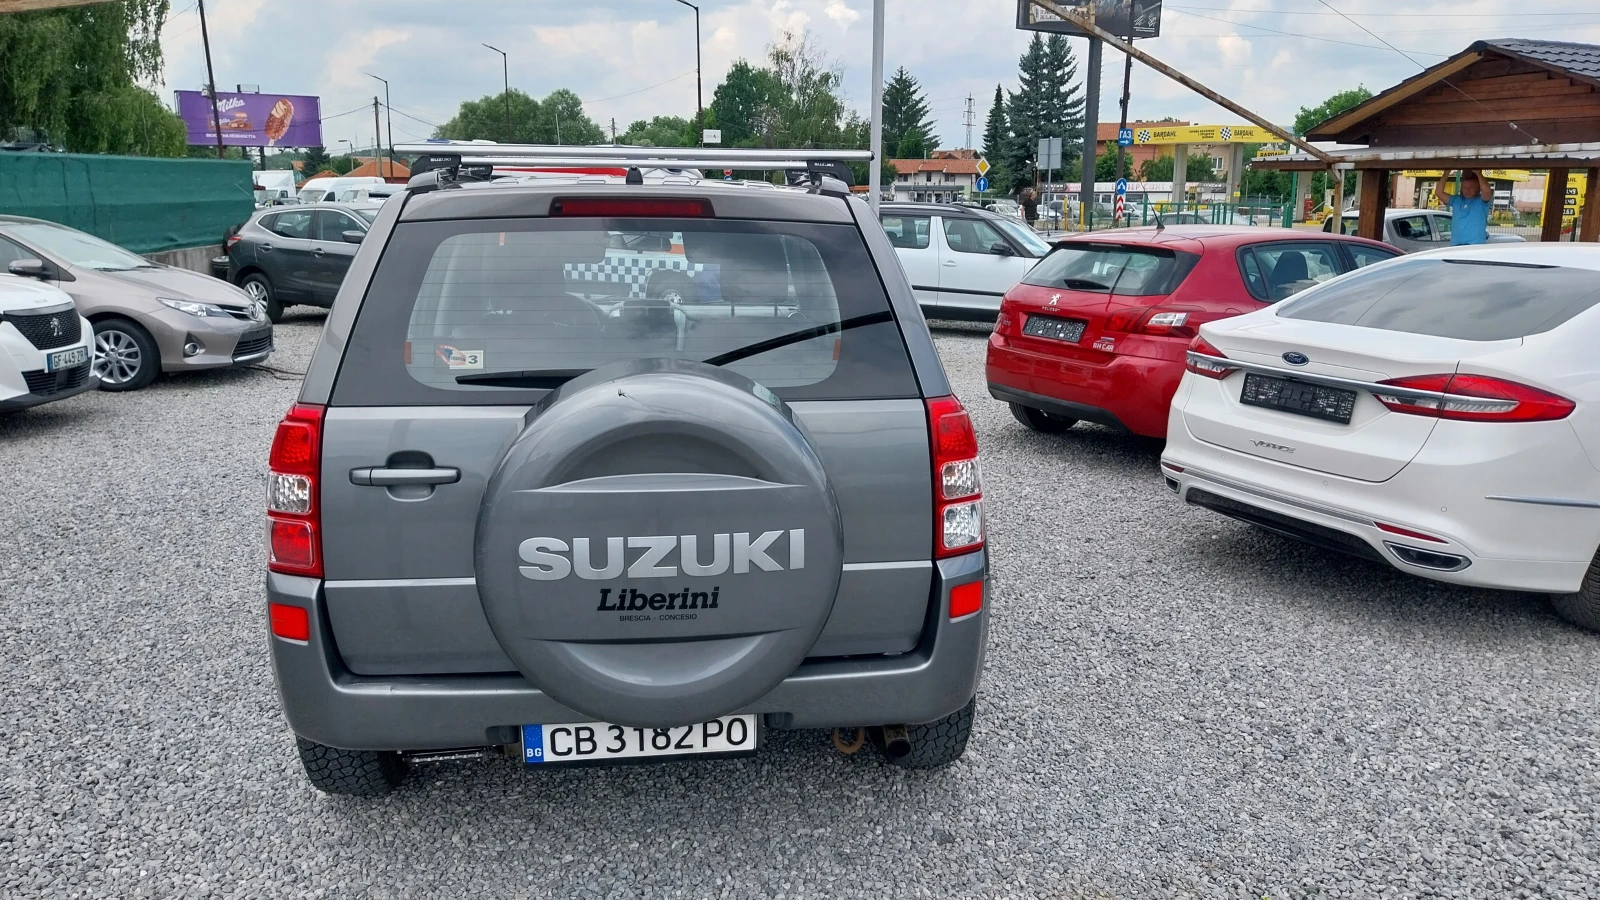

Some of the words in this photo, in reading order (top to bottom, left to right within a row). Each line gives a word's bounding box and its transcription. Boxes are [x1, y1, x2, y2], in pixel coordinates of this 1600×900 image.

[211, 97, 245, 112] Milka
[1119, 129, 1132, 139] ГАЗ
[1153, 130, 1177, 140] BARDAHL
[1233, 129, 1254, 139] BARDAHL
[467, 354, 479, 365] 3
[1286, 353, 1304, 363] Ford
[518, 528, 805, 581] SUZUKI
[596, 586, 720, 612] Liberini
[619, 614, 651, 622] BRESCIA
[659, 613, 698, 621] CONCESIO
[550, 726, 597, 756] CB
[605, 724, 694, 754] 3182
[526, 747, 542, 757] BG
